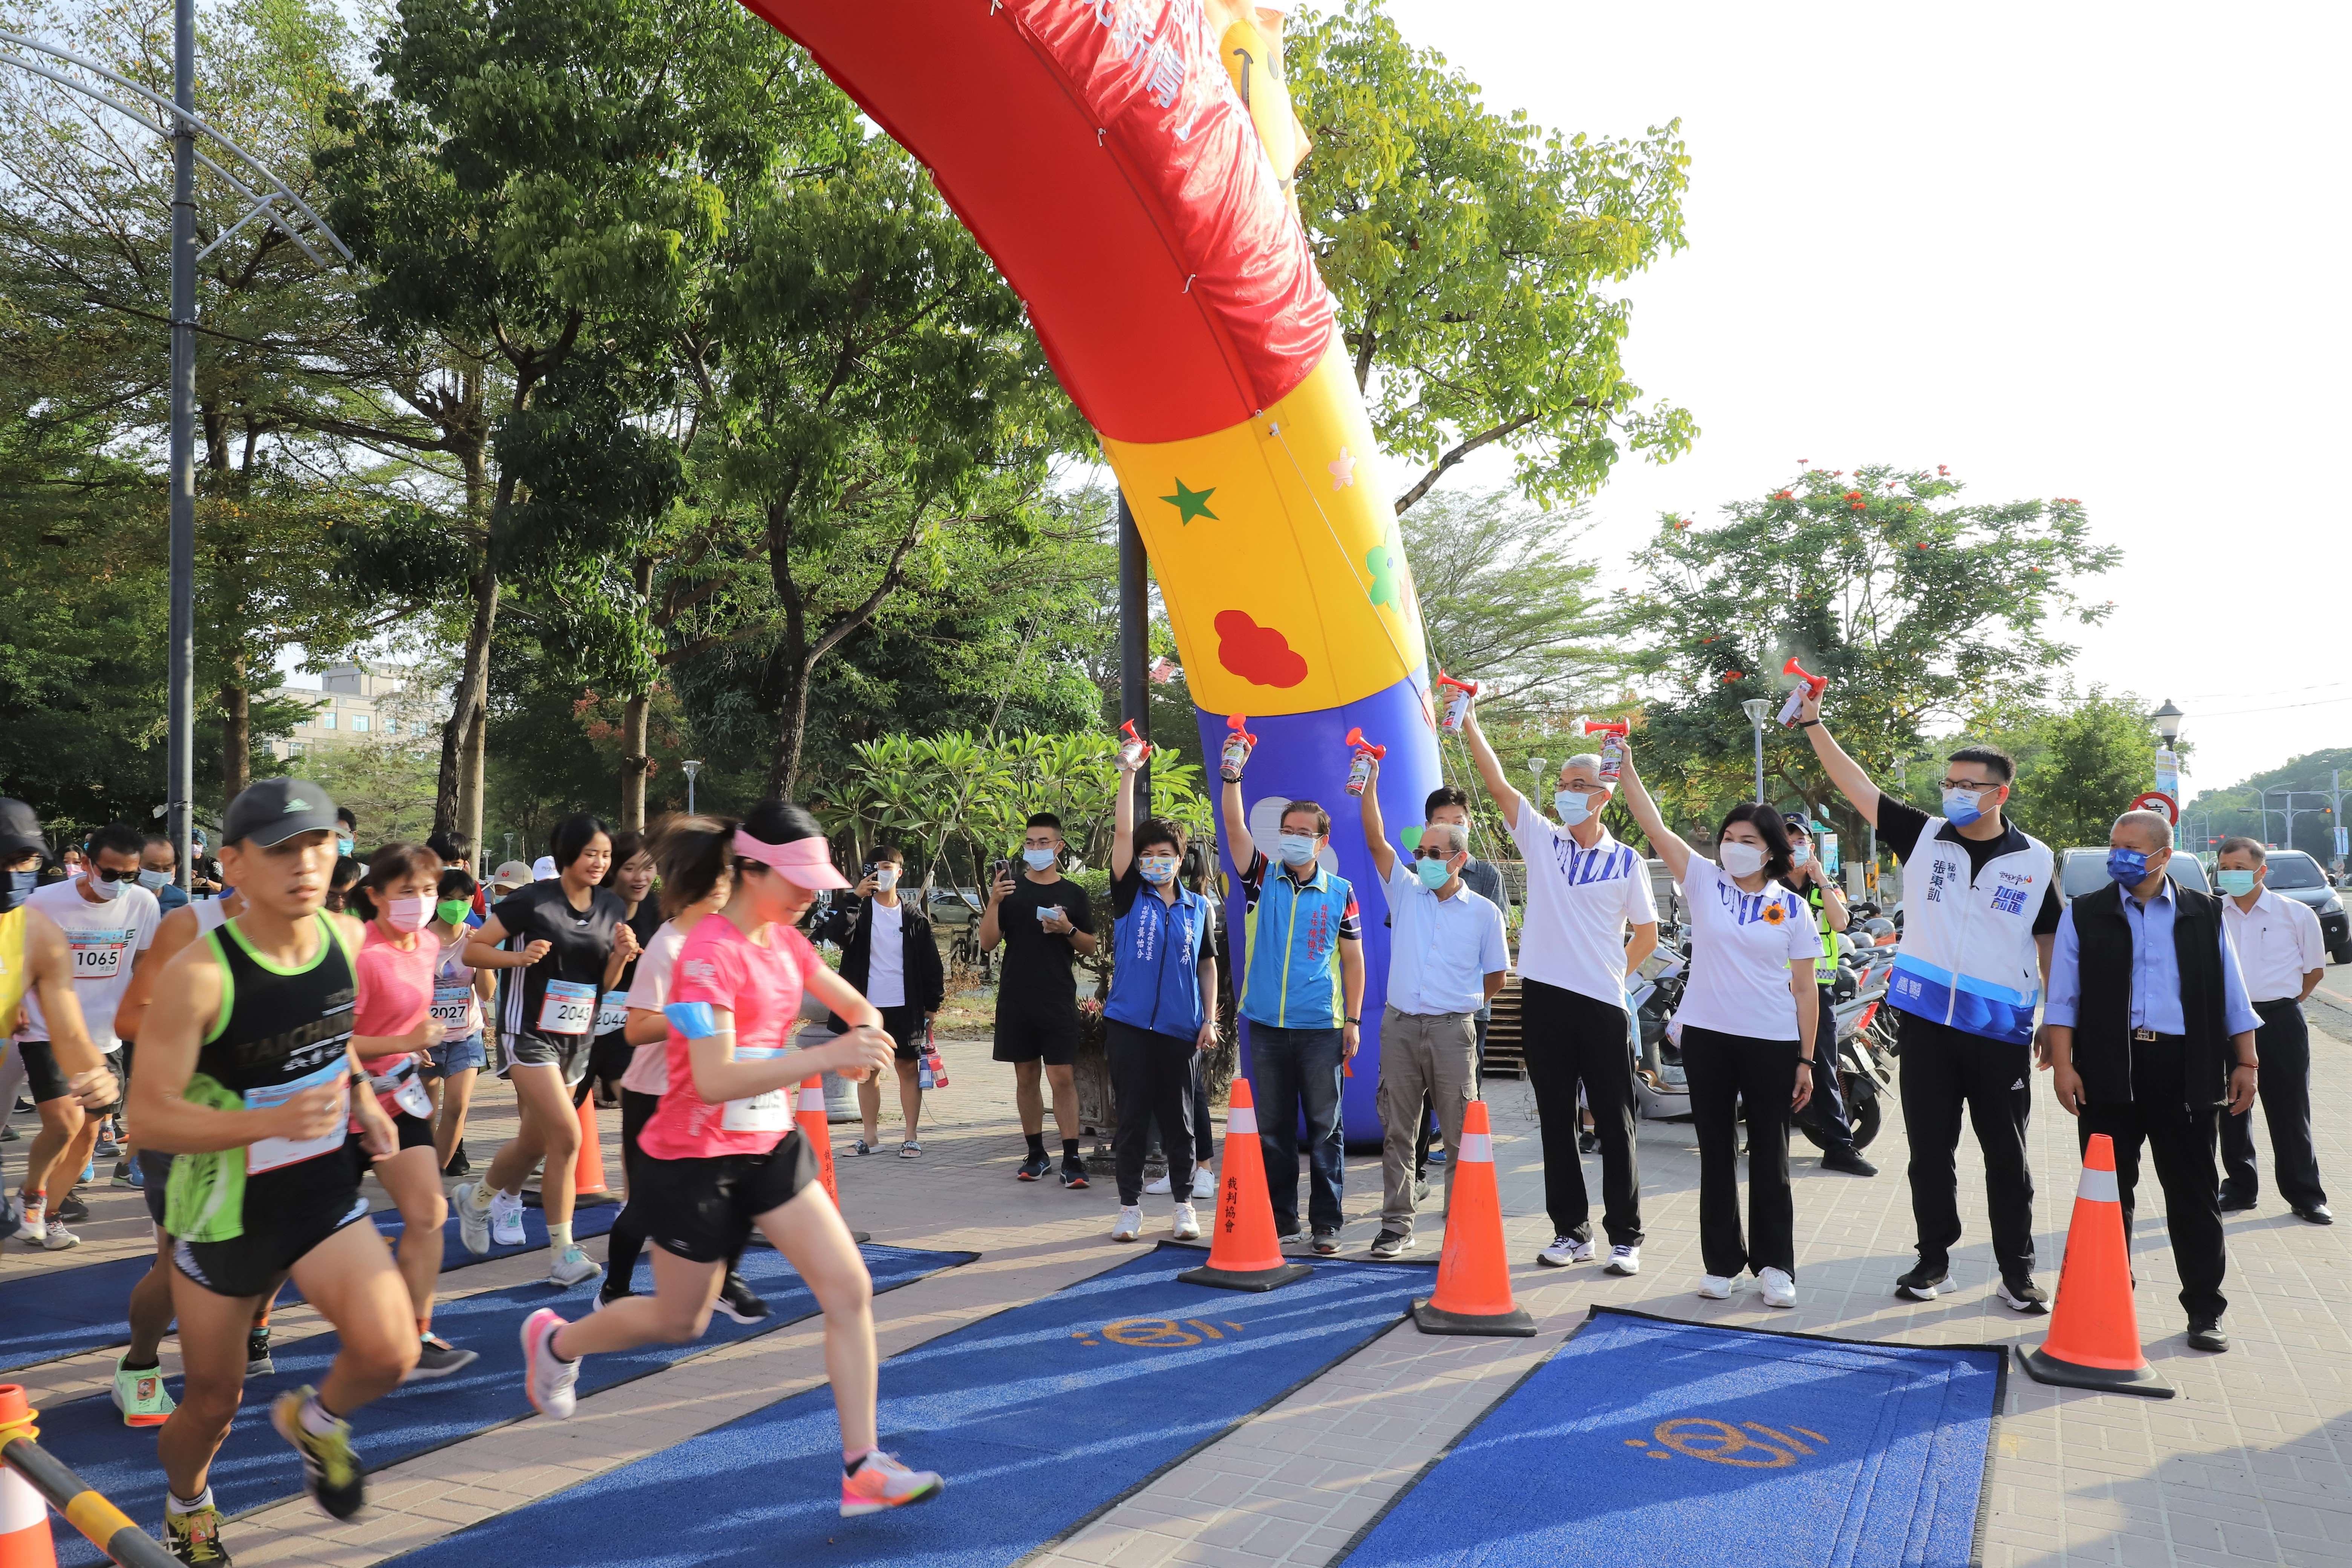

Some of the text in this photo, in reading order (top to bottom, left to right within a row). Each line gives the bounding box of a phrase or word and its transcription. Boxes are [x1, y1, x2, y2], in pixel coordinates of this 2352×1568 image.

[1927, 860, 1946, 902] 張東凱
[1947, 862, 1956, 882] 秘書
[1994, 885, 2028, 903] 加速
[1990, 897, 2023, 915] 前進
[1179, 918, 1194, 965] 雲林縣政府
[77, 952, 118, 966] 1065
[431, 1006, 466, 1019] 2027
[557, 1005, 590, 1021] 2043
[596, 1012, 628, 1026] 2044
[1225, 1176, 1237, 1233] 裁判協會
